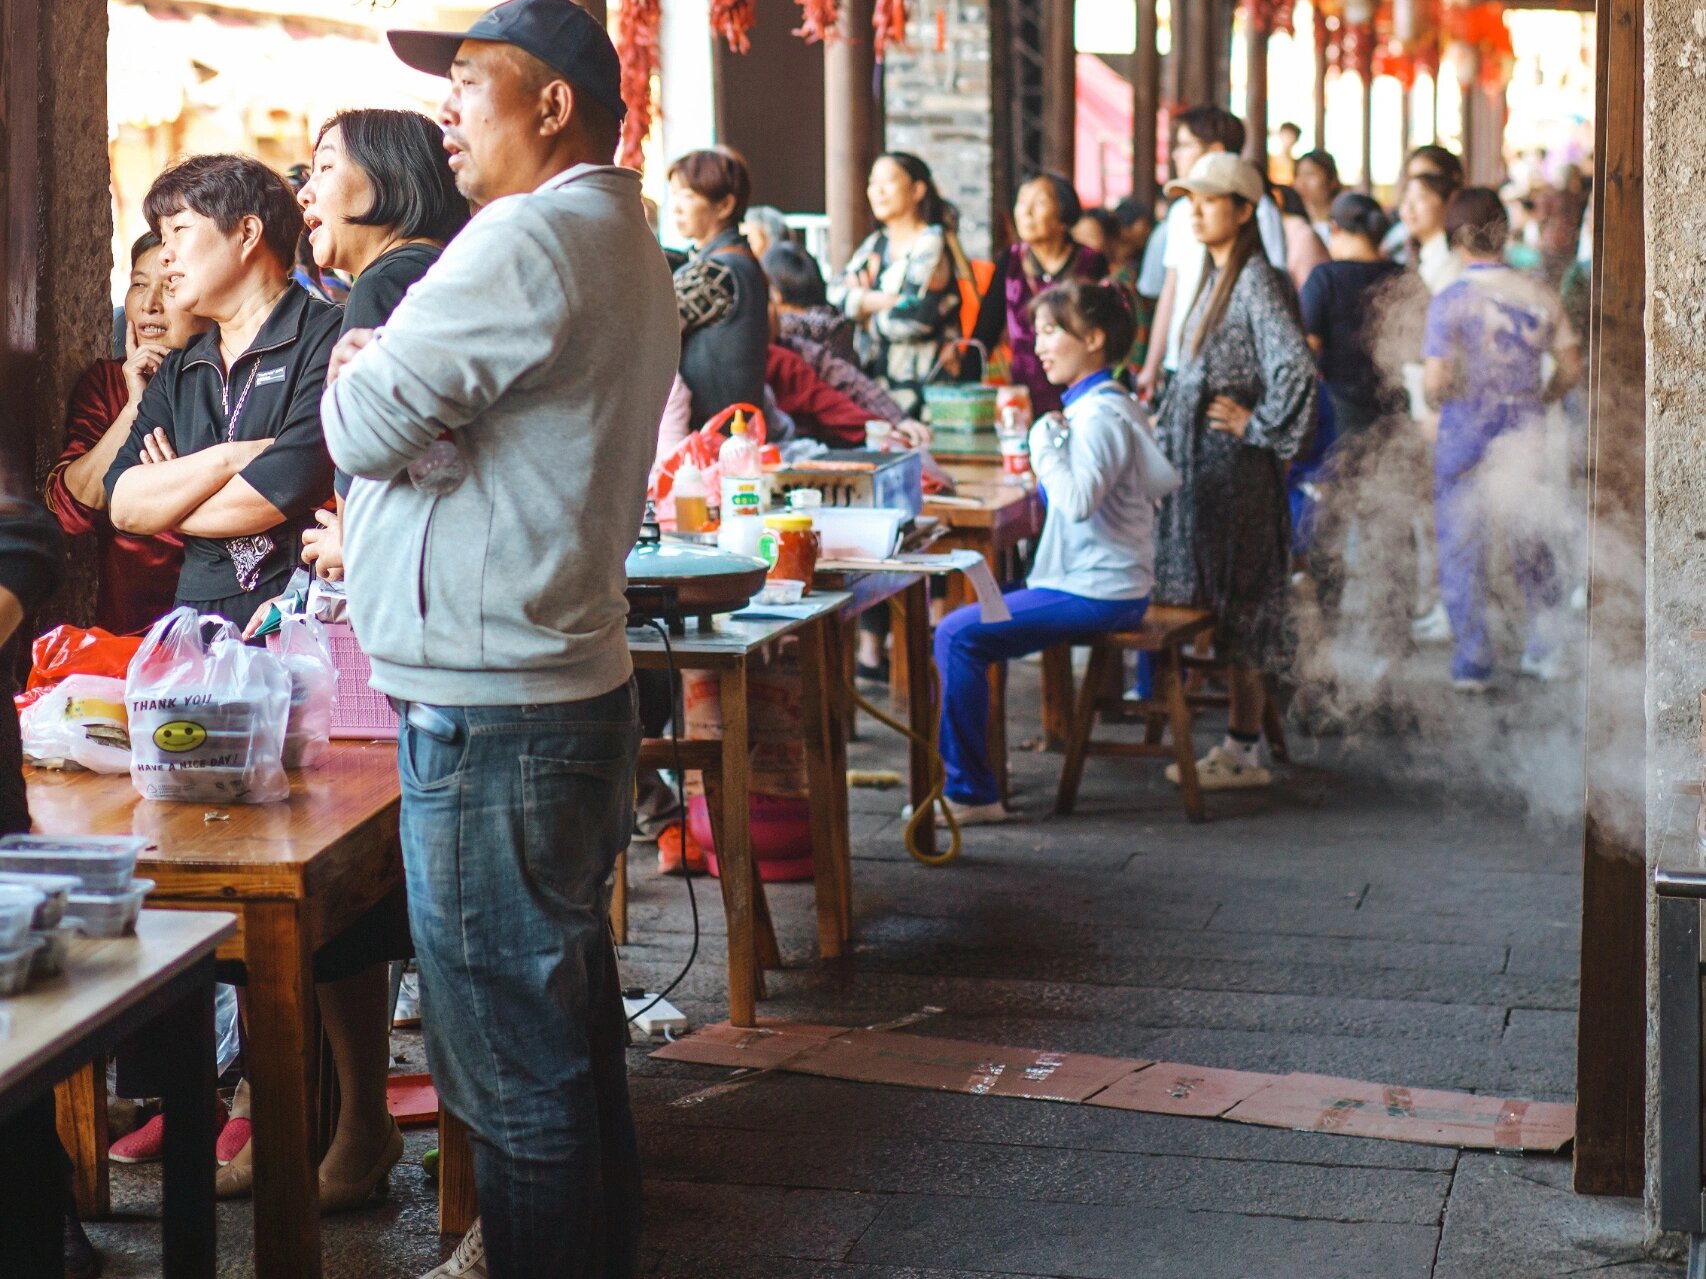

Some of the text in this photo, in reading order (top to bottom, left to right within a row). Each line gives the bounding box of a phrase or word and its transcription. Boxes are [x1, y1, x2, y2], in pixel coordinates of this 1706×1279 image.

[132, 693, 212, 712] THANK YOU
[137, 763, 163, 772] HAVE
[168, 763, 176, 772] A
[179, 759, 206, 770] NICE
